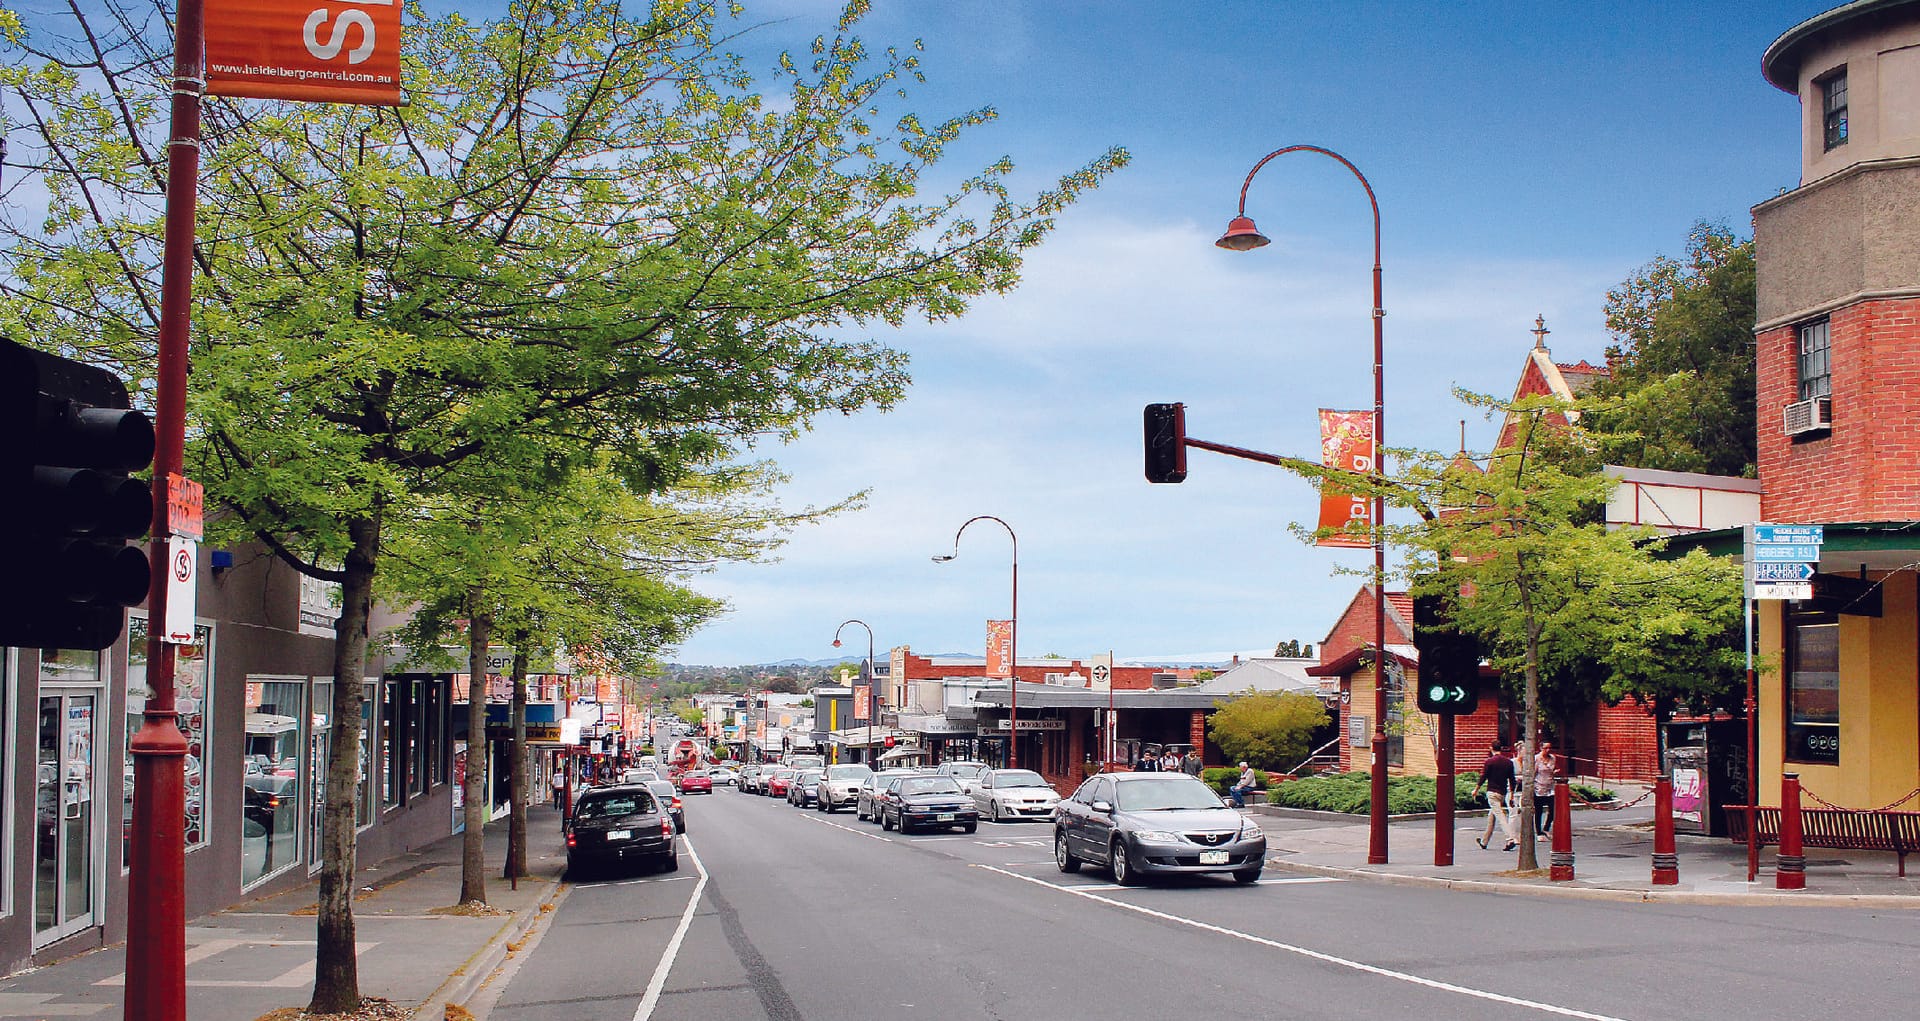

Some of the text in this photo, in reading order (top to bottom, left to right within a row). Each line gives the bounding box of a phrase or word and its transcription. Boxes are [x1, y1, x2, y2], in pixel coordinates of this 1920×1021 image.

[212, 64, 392, 84] www.heidelbergcentral.com.au
[1757, 547, 1795, 558] HEIDELBERG
[1756, 563, 1803, 572] HEIDELBERG
[1767, 586, 1800, 596] MOUNT
[998, 639, 1011, 674] Spring
